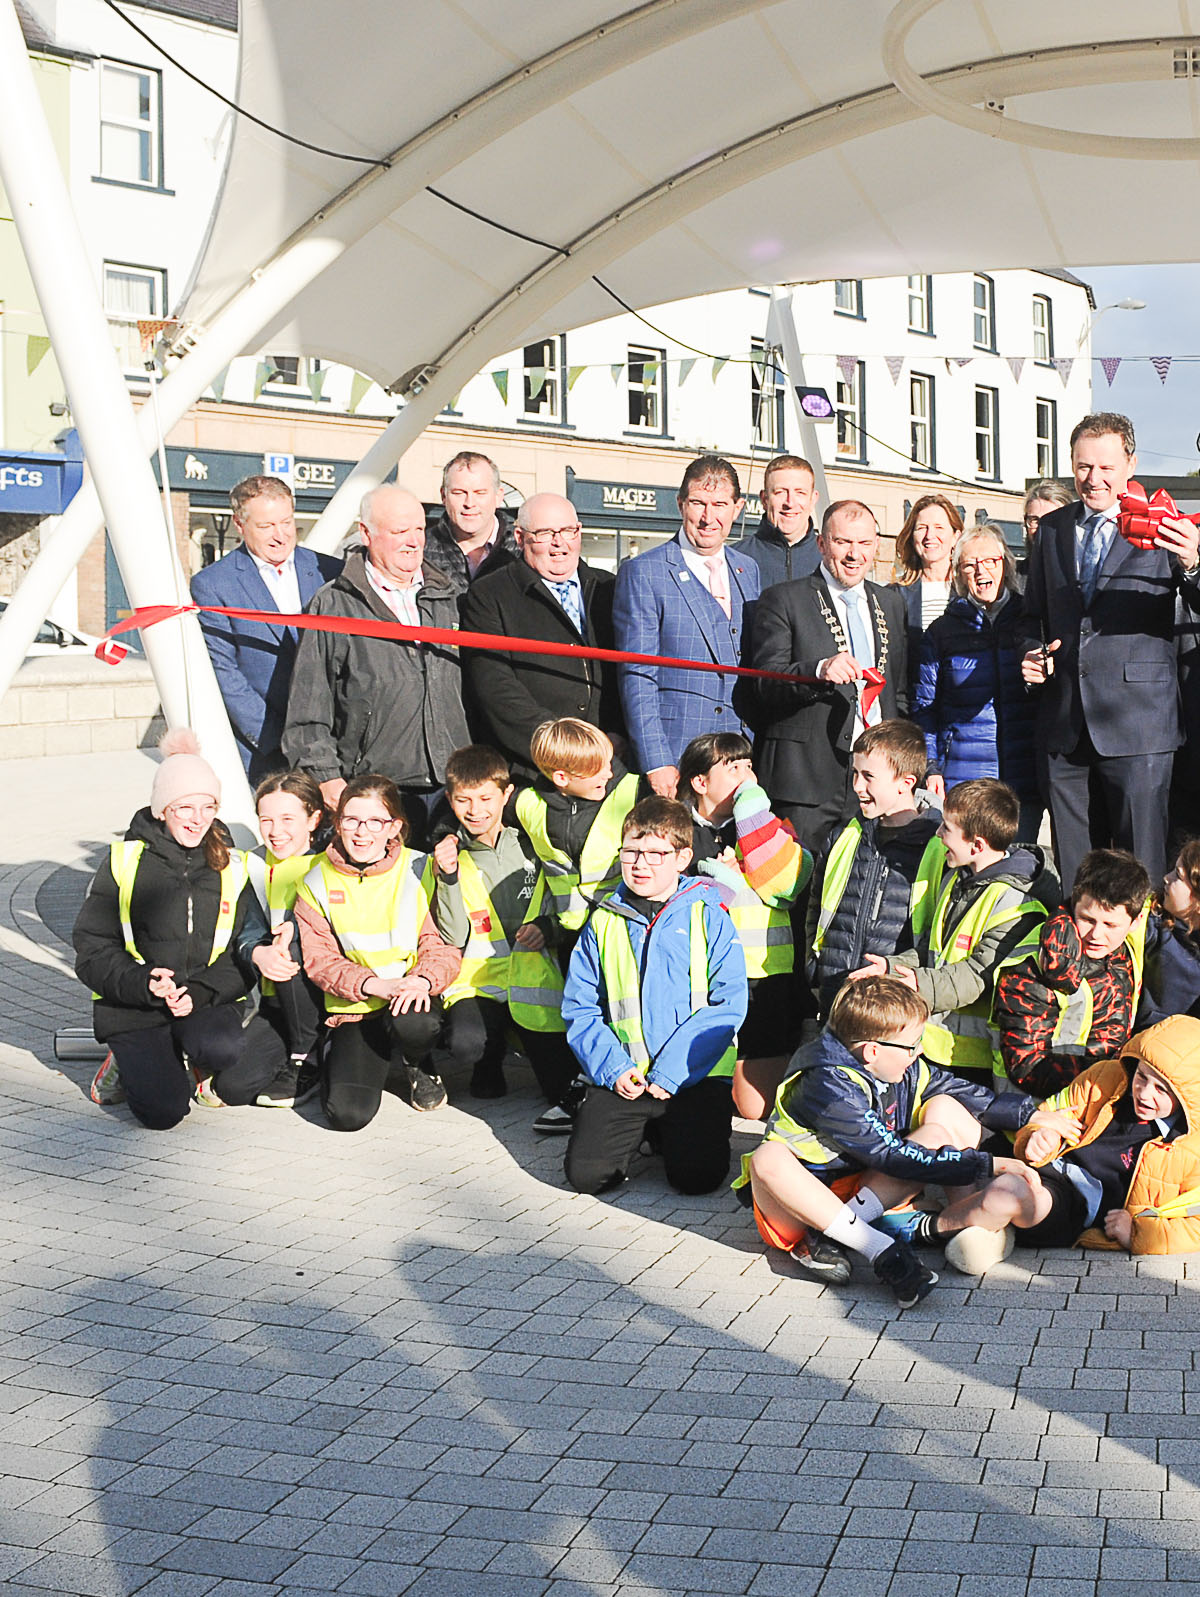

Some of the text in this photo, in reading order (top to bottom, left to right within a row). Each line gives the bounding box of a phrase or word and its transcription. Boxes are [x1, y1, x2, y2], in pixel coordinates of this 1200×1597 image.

[0, 466, 43, 490] fts
[294, 462, 335, 482] GEE
[603, 487, 657, 506] MAGEE
[517, 886, 534, 900] AX
[898, 1145, 962, 1166] ARMUR
